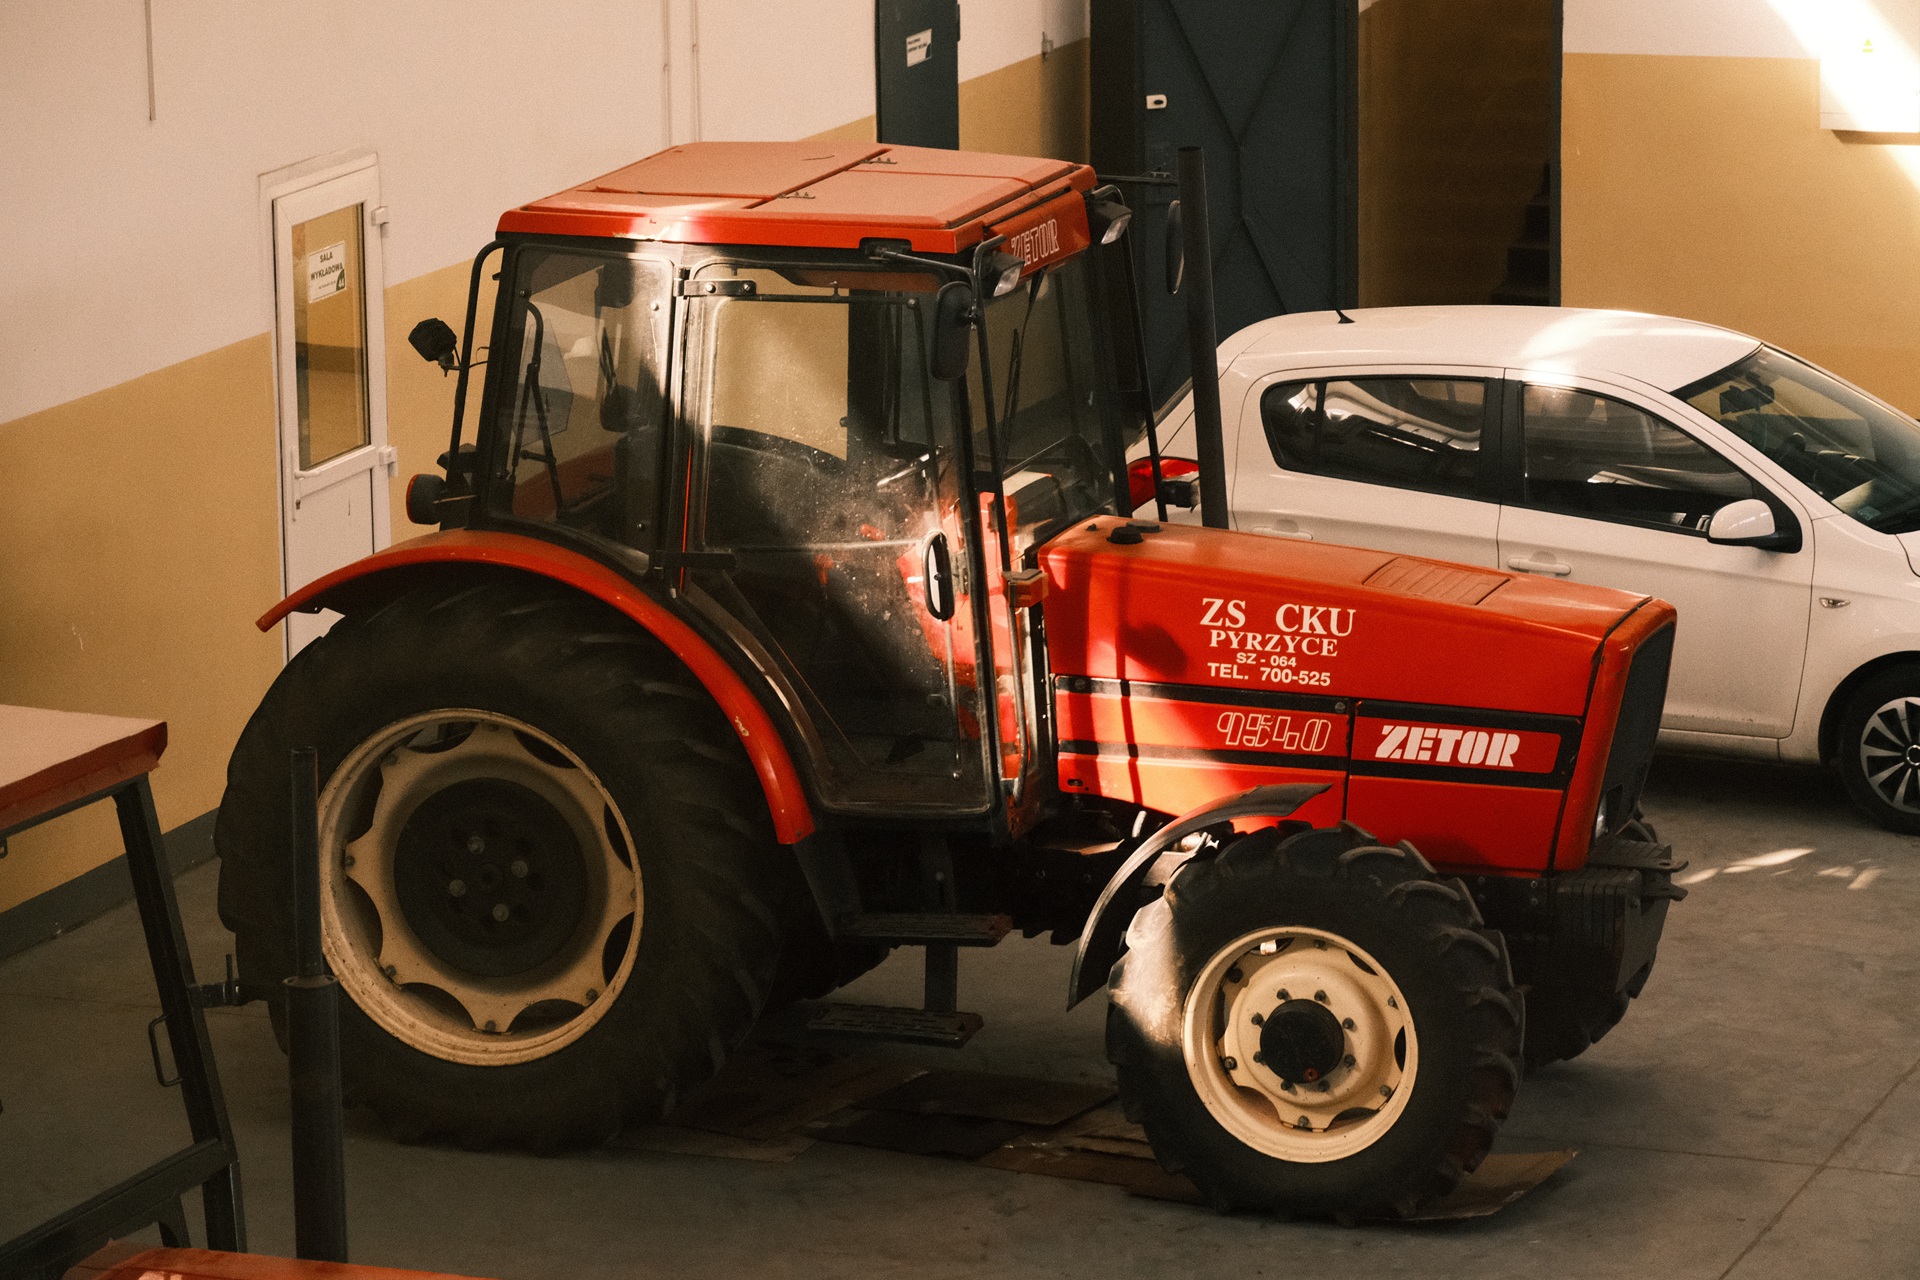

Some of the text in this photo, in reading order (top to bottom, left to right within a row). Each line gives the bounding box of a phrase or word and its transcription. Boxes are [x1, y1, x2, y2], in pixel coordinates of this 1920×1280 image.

[1011, 219, 1060, 267] ZETOR
[320, 252, 333, 263] SALA
[1200, 597, 1357, 637] ZS CKU
[1209, 629, 1338, 657] PYRZYCE
[1236, 652, 1257, 665] SZ
[1270, 655, 1297, 668] 064
[1207, 662, 1331, 687] TEL. 700-525
[1375, 725, 1520, 767] ZETOR
